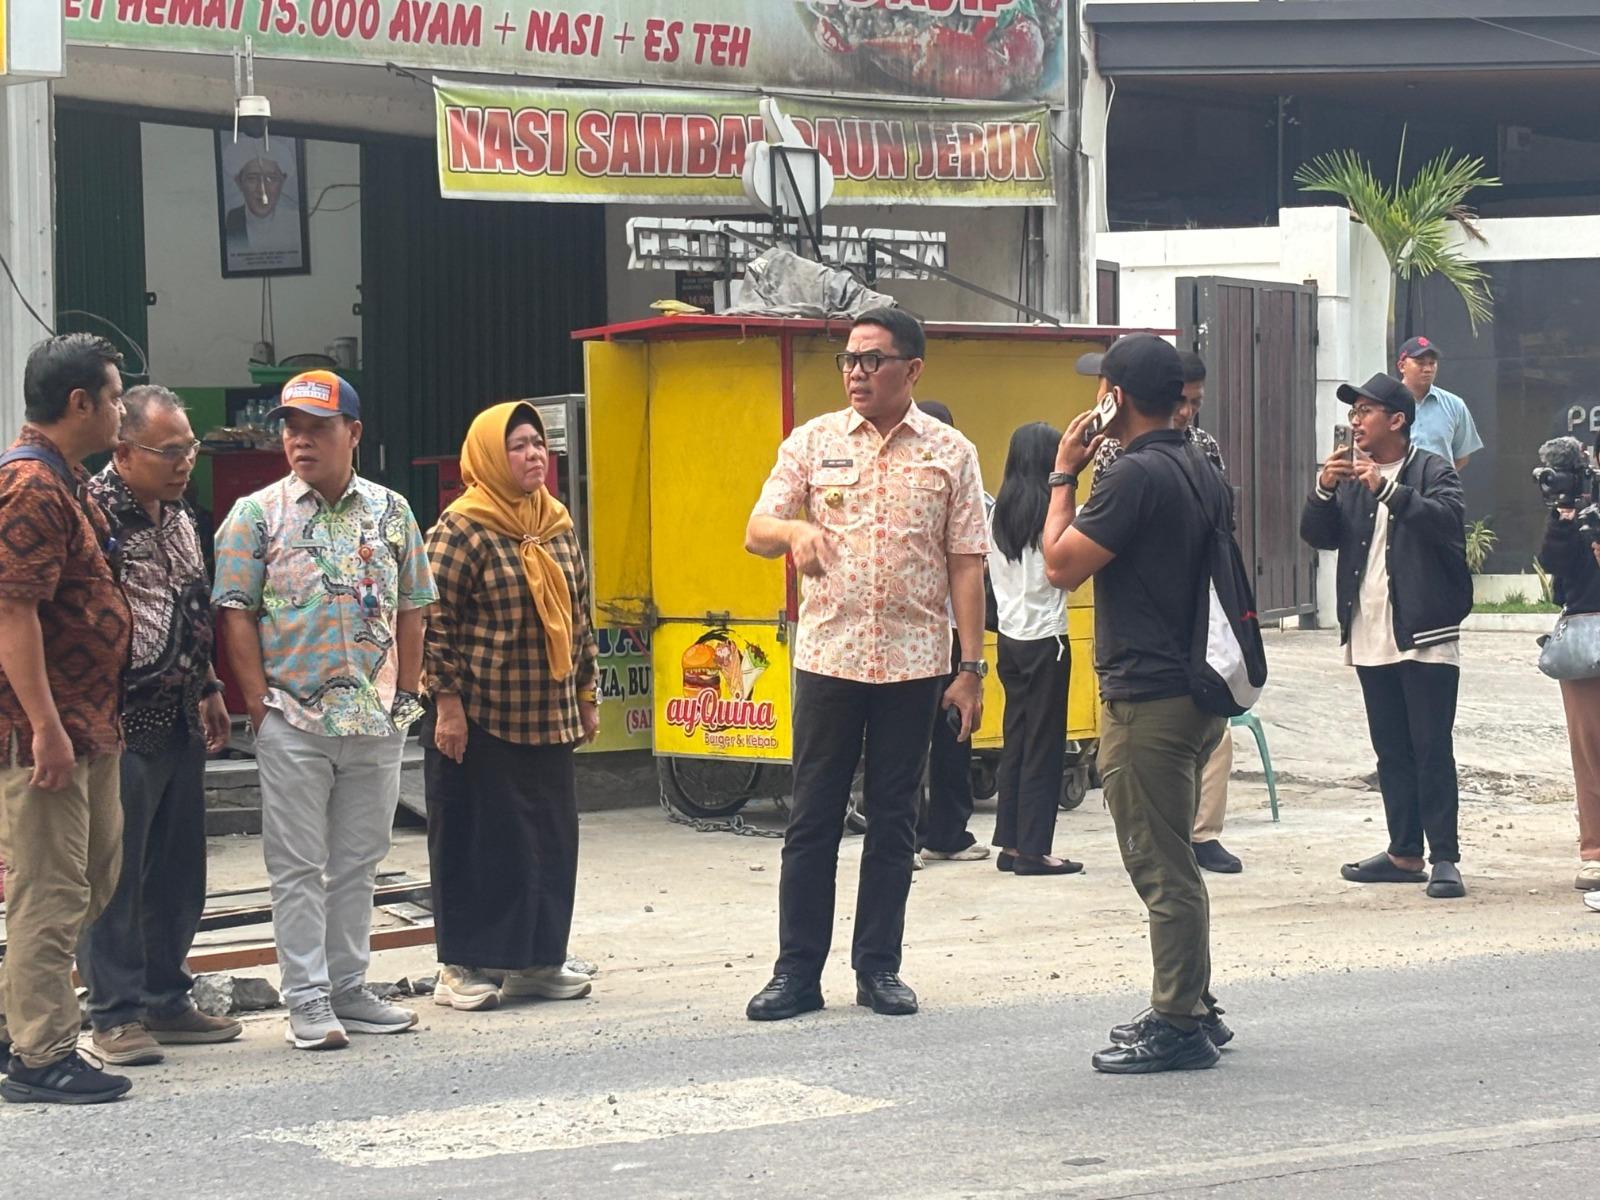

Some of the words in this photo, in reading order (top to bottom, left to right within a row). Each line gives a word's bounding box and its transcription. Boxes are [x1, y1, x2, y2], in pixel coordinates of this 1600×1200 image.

[258, 0, 381, 40] 15.000
[387, 0, 484, 48] AYAM
[524, 9, 605, 58] NASI
[643, 18, 685, 63] ES
[692, 22, 753, 68] TEH
[445, 105, 568, 176] NASI
[915, 121, 1046, 182] JERUK
[627, 665, 652, 696] BU
[666, 687, 776, 737] ayQuina
[704, 732, 736, 748] Burger
[745, 734, 779, 749] Kebab
